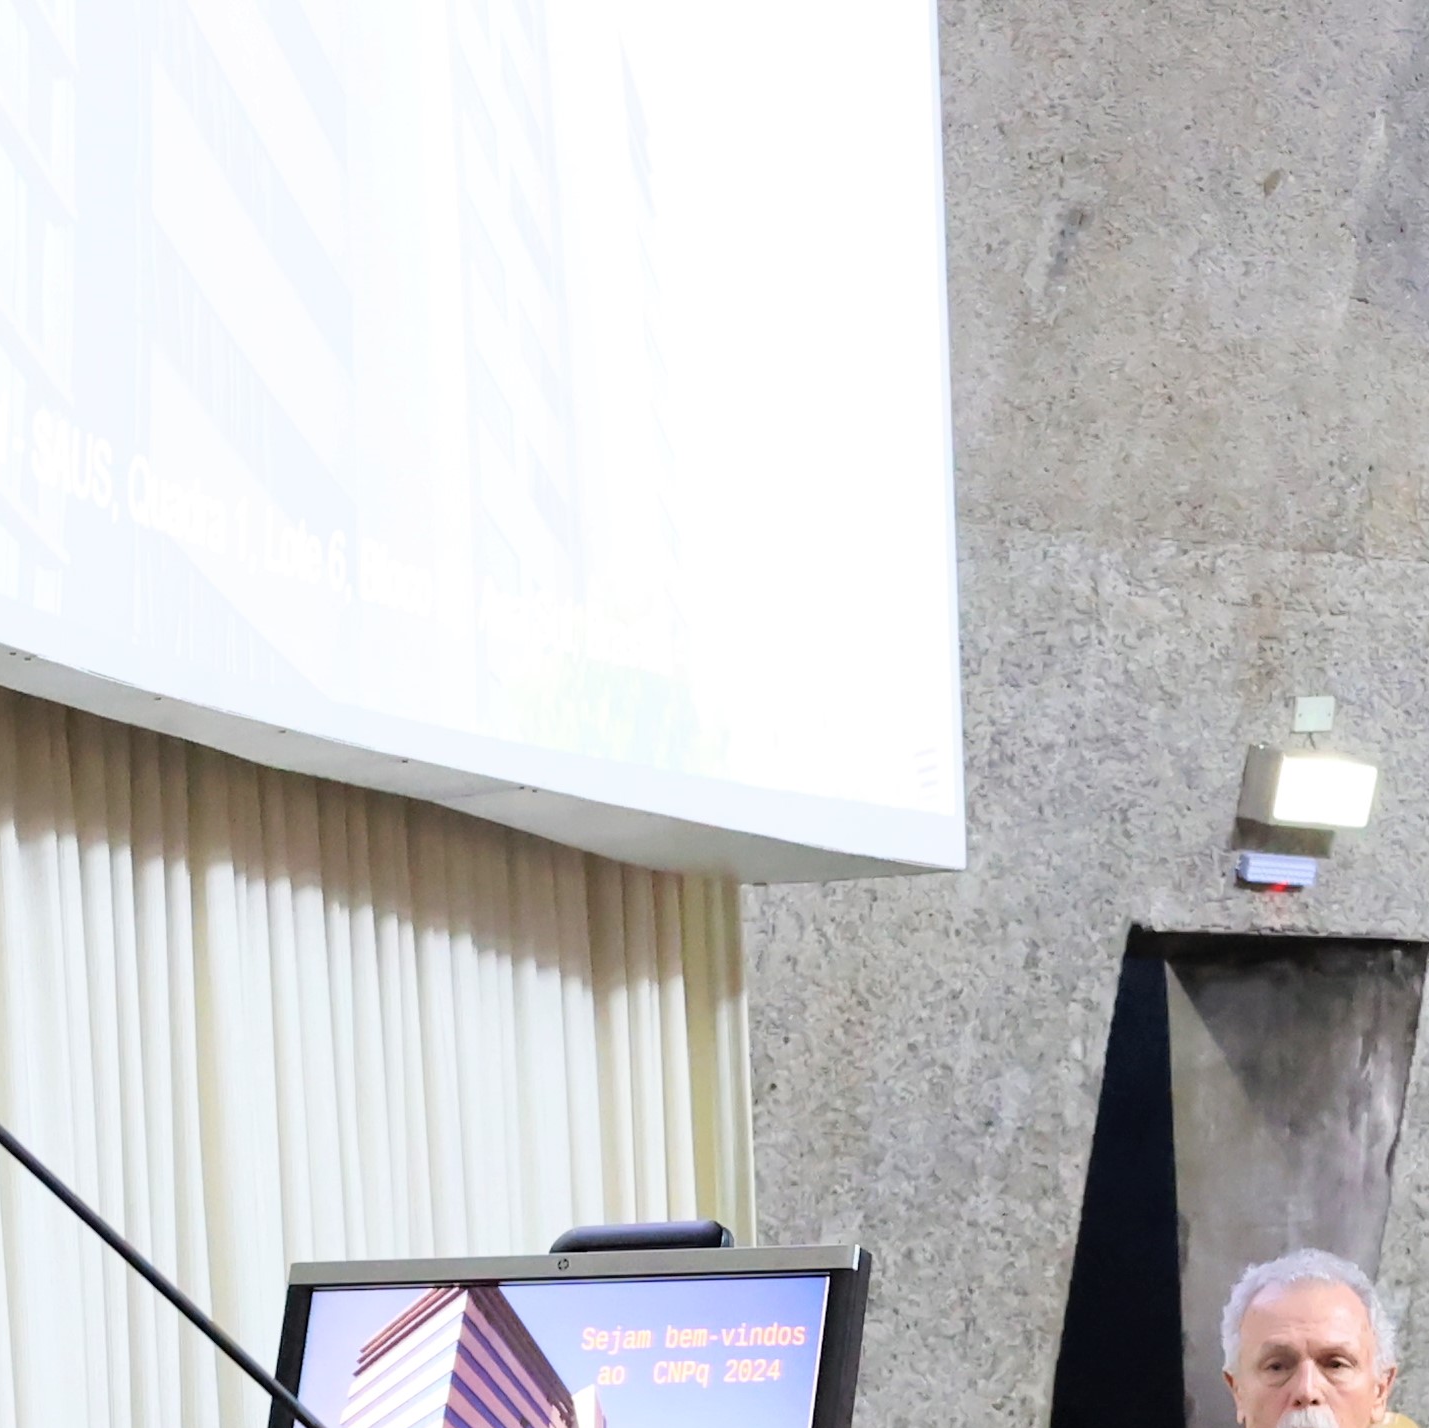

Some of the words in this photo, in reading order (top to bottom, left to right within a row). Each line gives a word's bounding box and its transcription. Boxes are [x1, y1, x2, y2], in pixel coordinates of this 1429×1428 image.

[32, 407, 118, 524] SAUS,
[129, 454, 227, 555] Quadra
[235, 497, 256, 575] 1,
[264, 505, 324, 584] Lote
[328, 530, 352, 605] 6,
[581, 1325, 652, 1355] Sejam
[665, 1321, 807, 1349] bem-vindos
[597, 1364, 626, 1386] ao
[653, 1360, 710, 1388] CNPq
[723, 1358, 781, 1384] 2024
